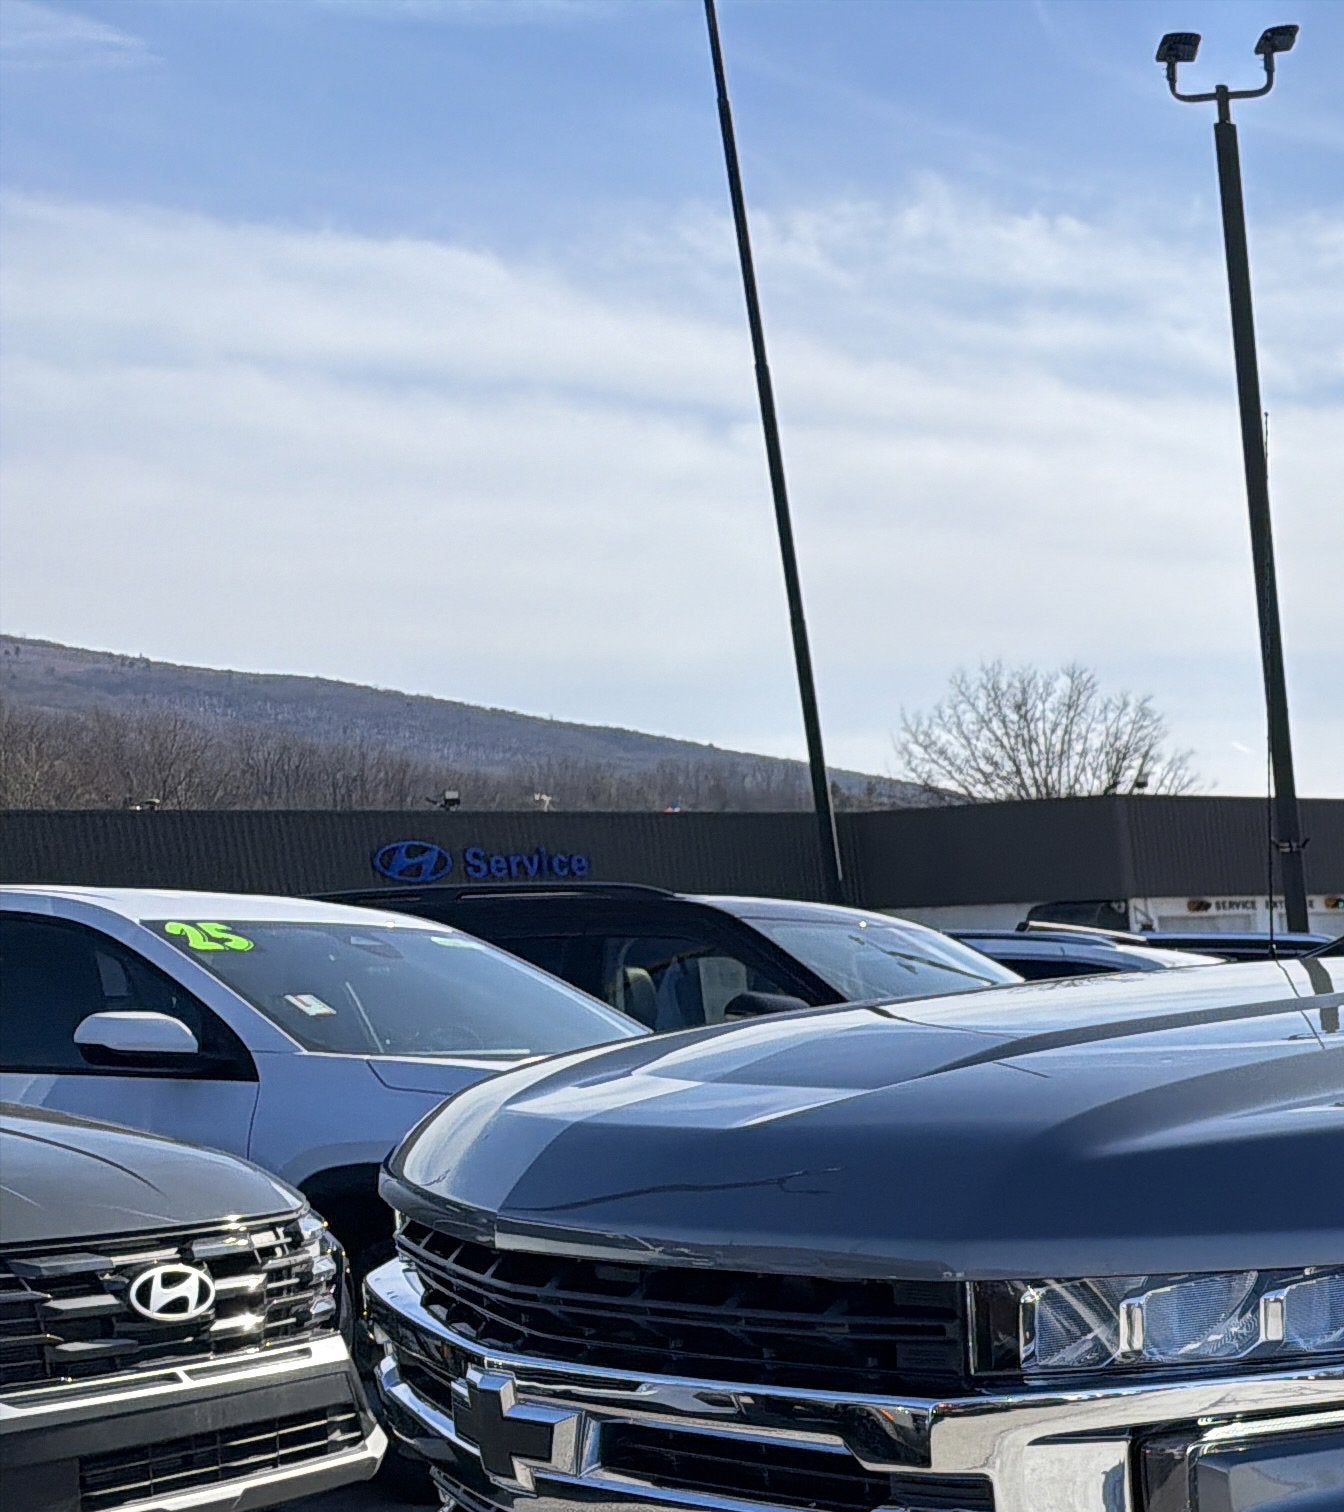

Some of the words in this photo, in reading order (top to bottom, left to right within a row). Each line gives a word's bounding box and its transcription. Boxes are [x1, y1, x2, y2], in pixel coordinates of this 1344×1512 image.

[464, 846, 588, 879] Service
[1215, 900, 1257, 911] SERVICE
[164, 921, 255, 951] 25
